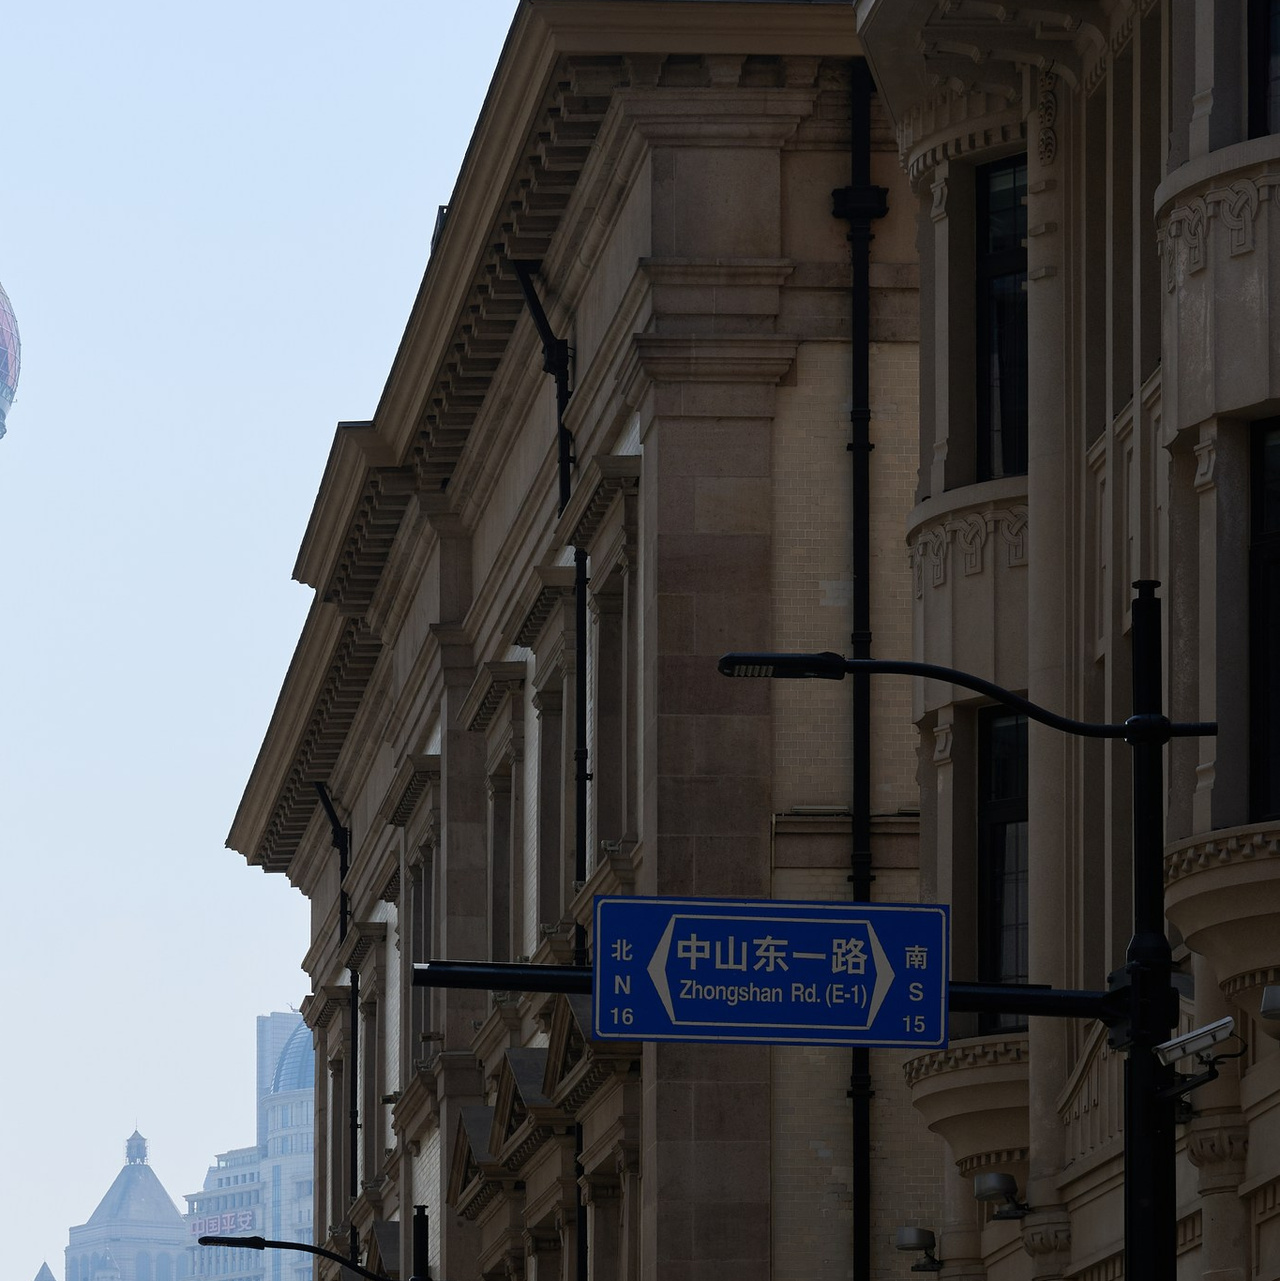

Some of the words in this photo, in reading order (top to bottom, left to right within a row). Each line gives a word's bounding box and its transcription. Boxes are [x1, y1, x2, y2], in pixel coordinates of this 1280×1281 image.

[611, 938, 633, 961] 北
[677, 933, 868, 975] 中山东一路
[905, 945, 928, 970] 南
[614, 976, 630, 995] N
[679, 979, 783, 1007] Zhongshan
[791, 983, 821, 1005] Rd.
[825, 983, 867, 1008] (E-1)
[909, 983, 924, 1002] S
[610, 1007, 634, 1026] 16
[902, 1015, 926, 1034] 15
[190, 1210, 252, 1237] 中国平安
